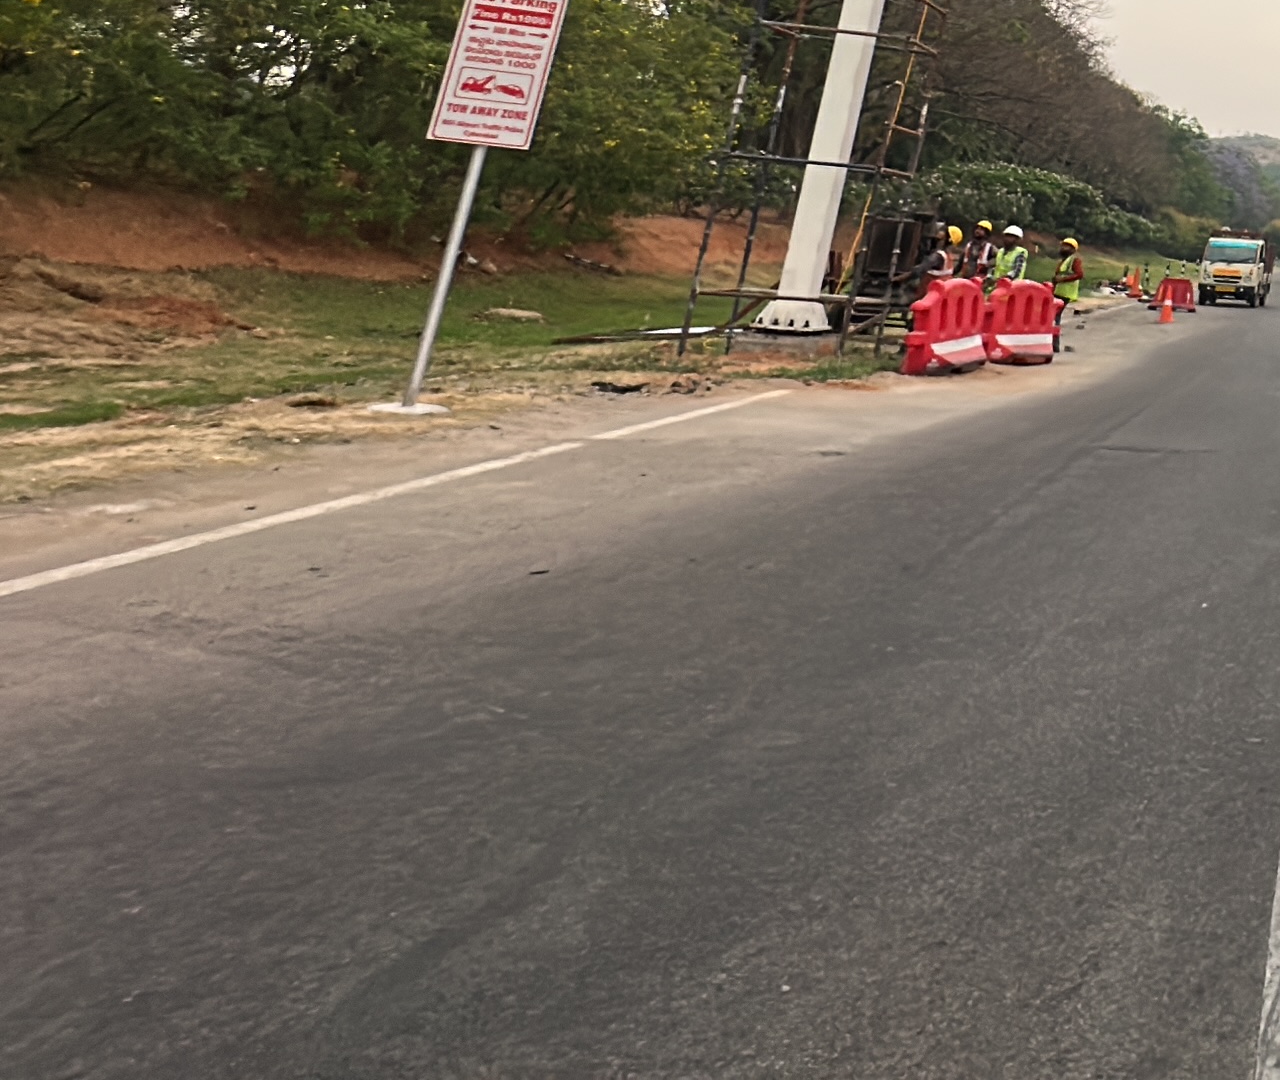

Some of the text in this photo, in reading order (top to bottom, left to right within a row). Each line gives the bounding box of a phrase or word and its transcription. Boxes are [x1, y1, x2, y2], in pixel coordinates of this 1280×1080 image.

[447, 103, 529, 120] TOW AWAY ZONE
